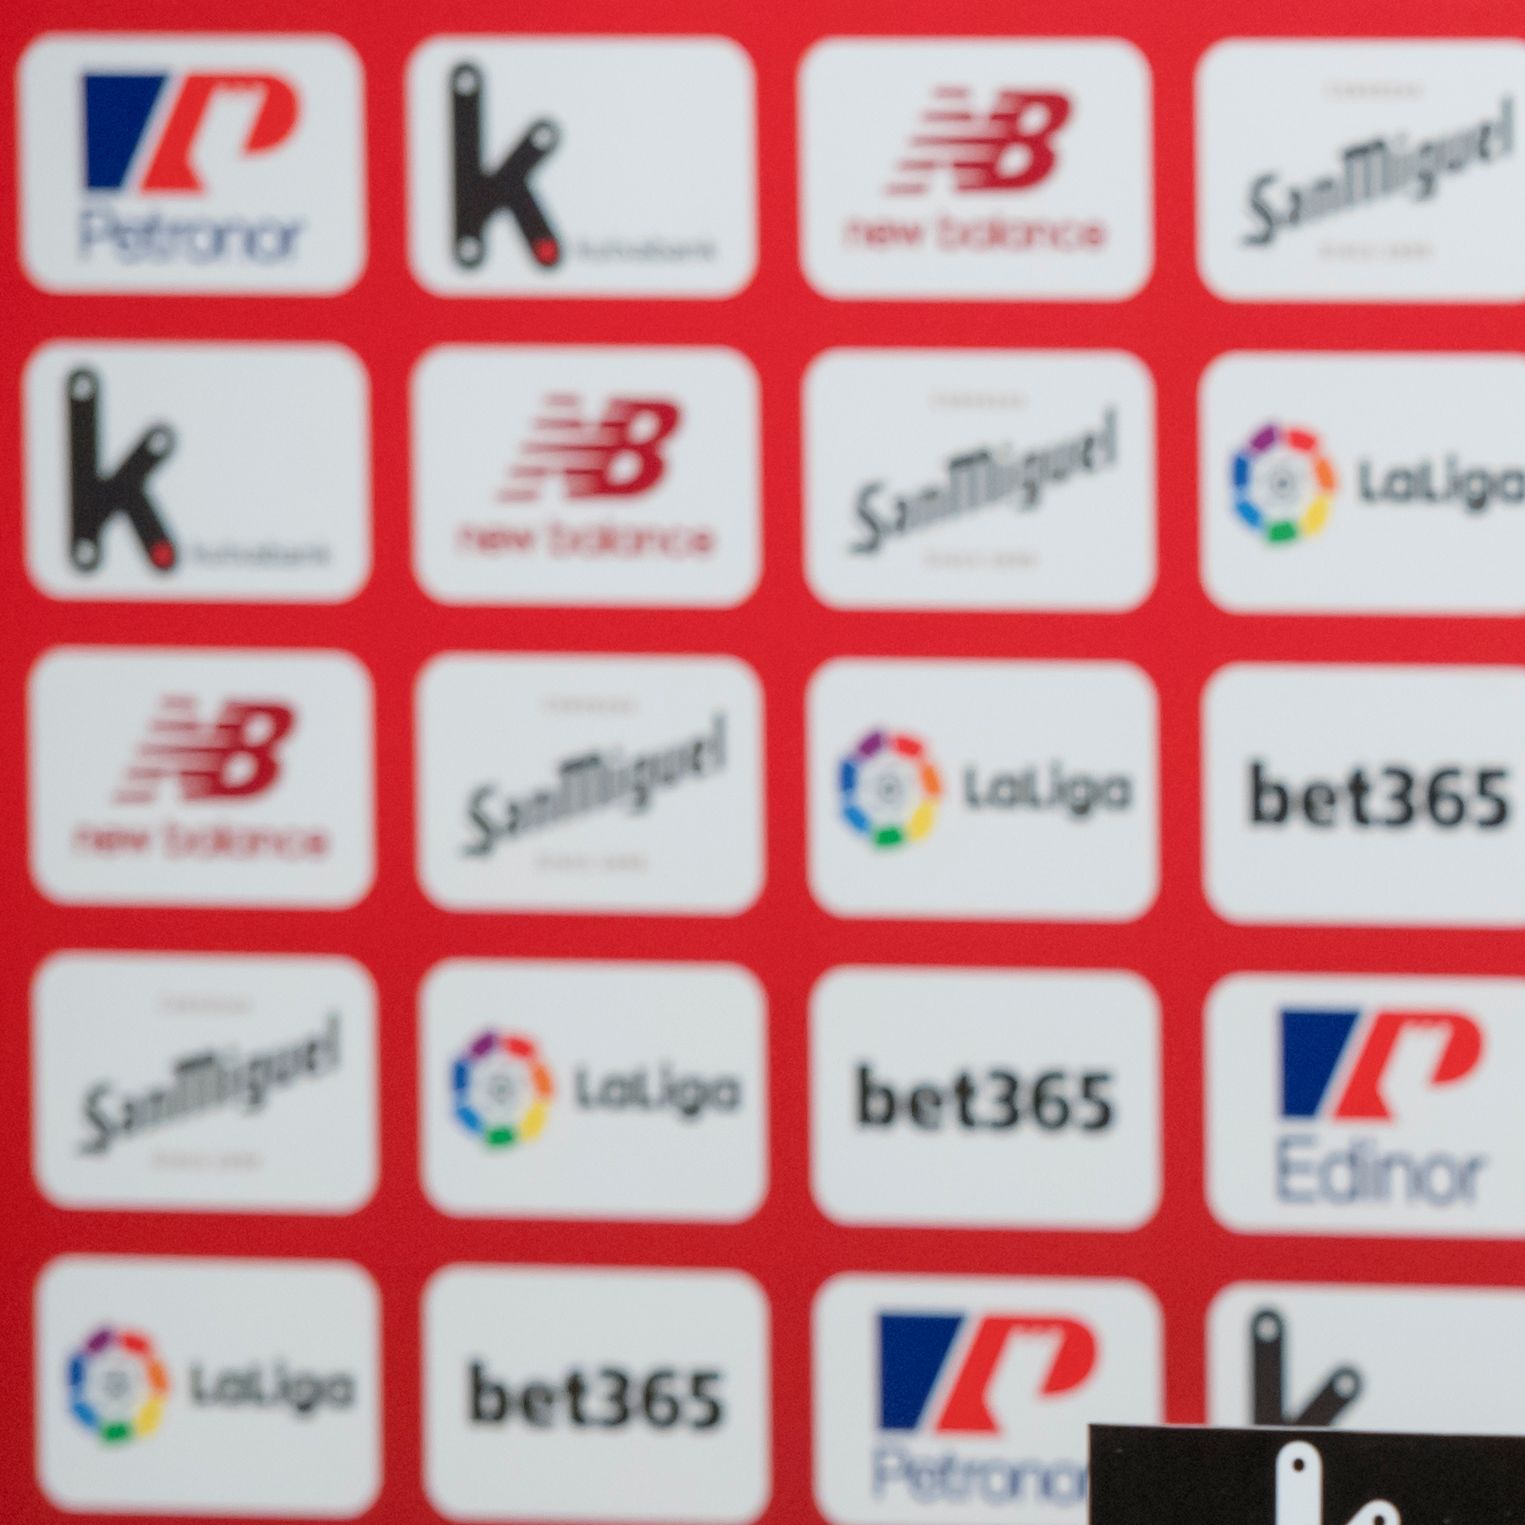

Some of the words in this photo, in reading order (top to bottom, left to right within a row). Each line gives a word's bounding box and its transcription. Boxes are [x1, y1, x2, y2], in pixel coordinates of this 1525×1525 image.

[1239, 96, 1516, 248] SanMiguel
[77, 202, 303, 265] Petronor
[846, 220, 925, 249] new
[938, 217, 1106, 250] balance
[458, 526, 536, 554] new
[549, 523, 715, 557] balance
[963, 761, 1135, 823] LaLiga
[1249, 759, 1511, 831] bet365
[74, 827, 152, 855] new
[164, 824, 329, 858] balance
[574, 1066, 743, 1124] LaLiga
[855, 1062, 1116, 1134] bet365
[1274, 1132, 1488, 1208] Edinor
[189, 1362, 357, 1420] LaLiga
[468, 1359, 725, 1432] bet365
[870, 1446, 1087, 1508] Petrono
